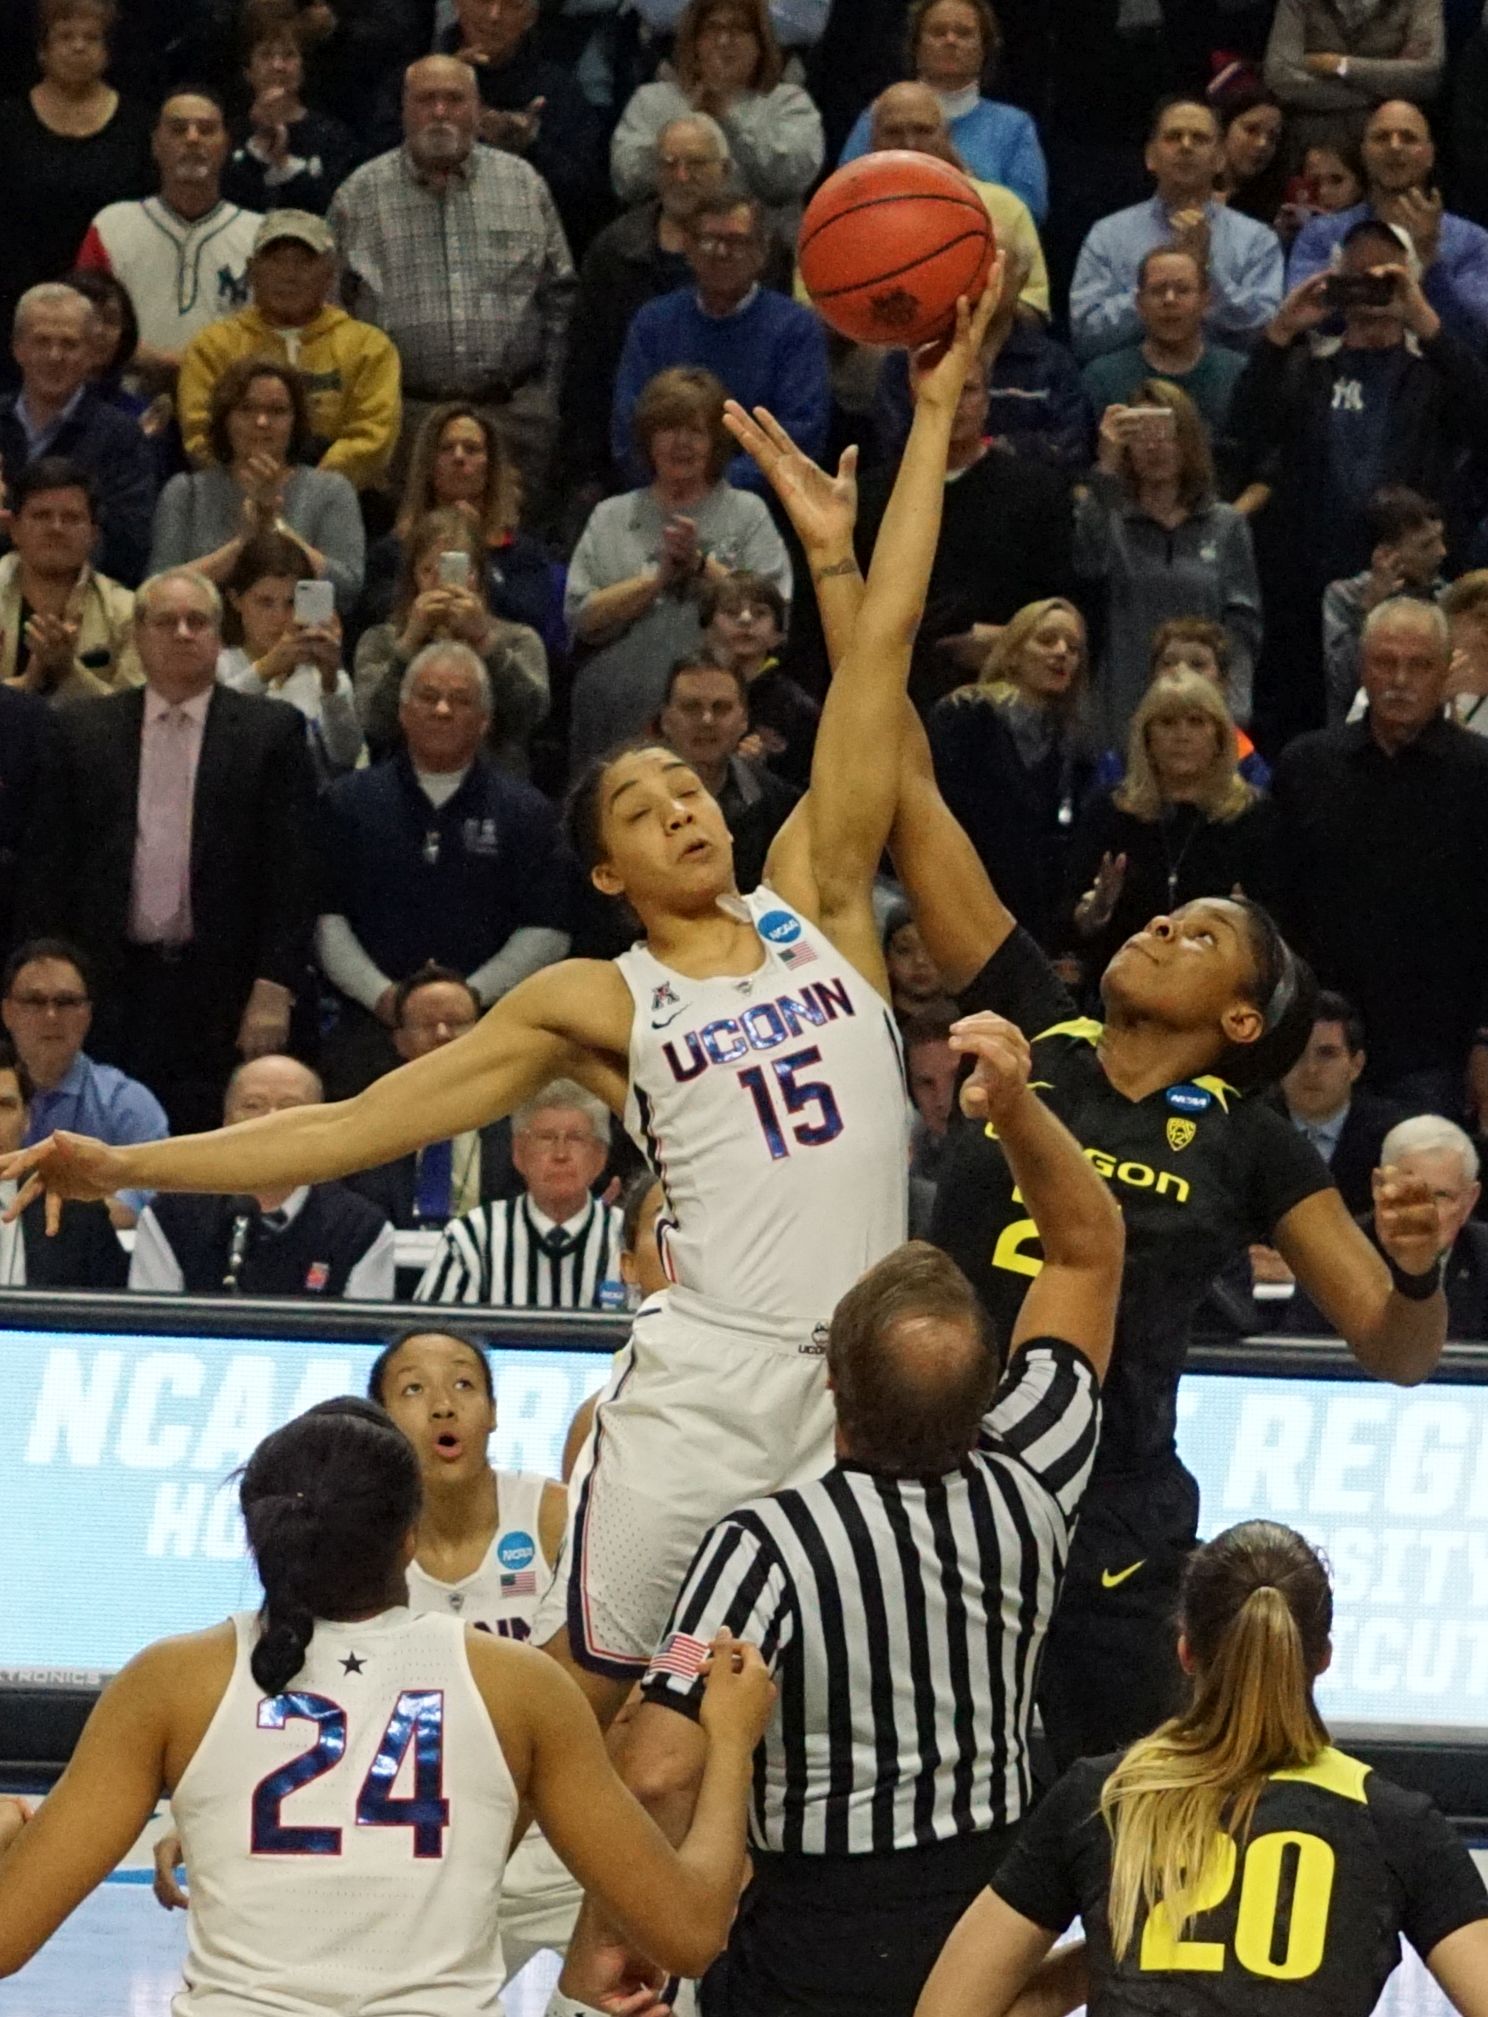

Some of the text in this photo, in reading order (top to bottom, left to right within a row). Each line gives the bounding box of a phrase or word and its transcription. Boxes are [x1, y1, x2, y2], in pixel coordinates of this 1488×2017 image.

[768, 917, 800, 941] NCAA
[661, 977, 856, 1083] UCONN
[737, 1044, 845, 1161] 15
[798, 1344, 828, 1355] UCO
[502, 1545, 534, 1562] NCAA
[250, 1689, 450, 1859] 24
[1140, 1831, 1336, 1980] 20
